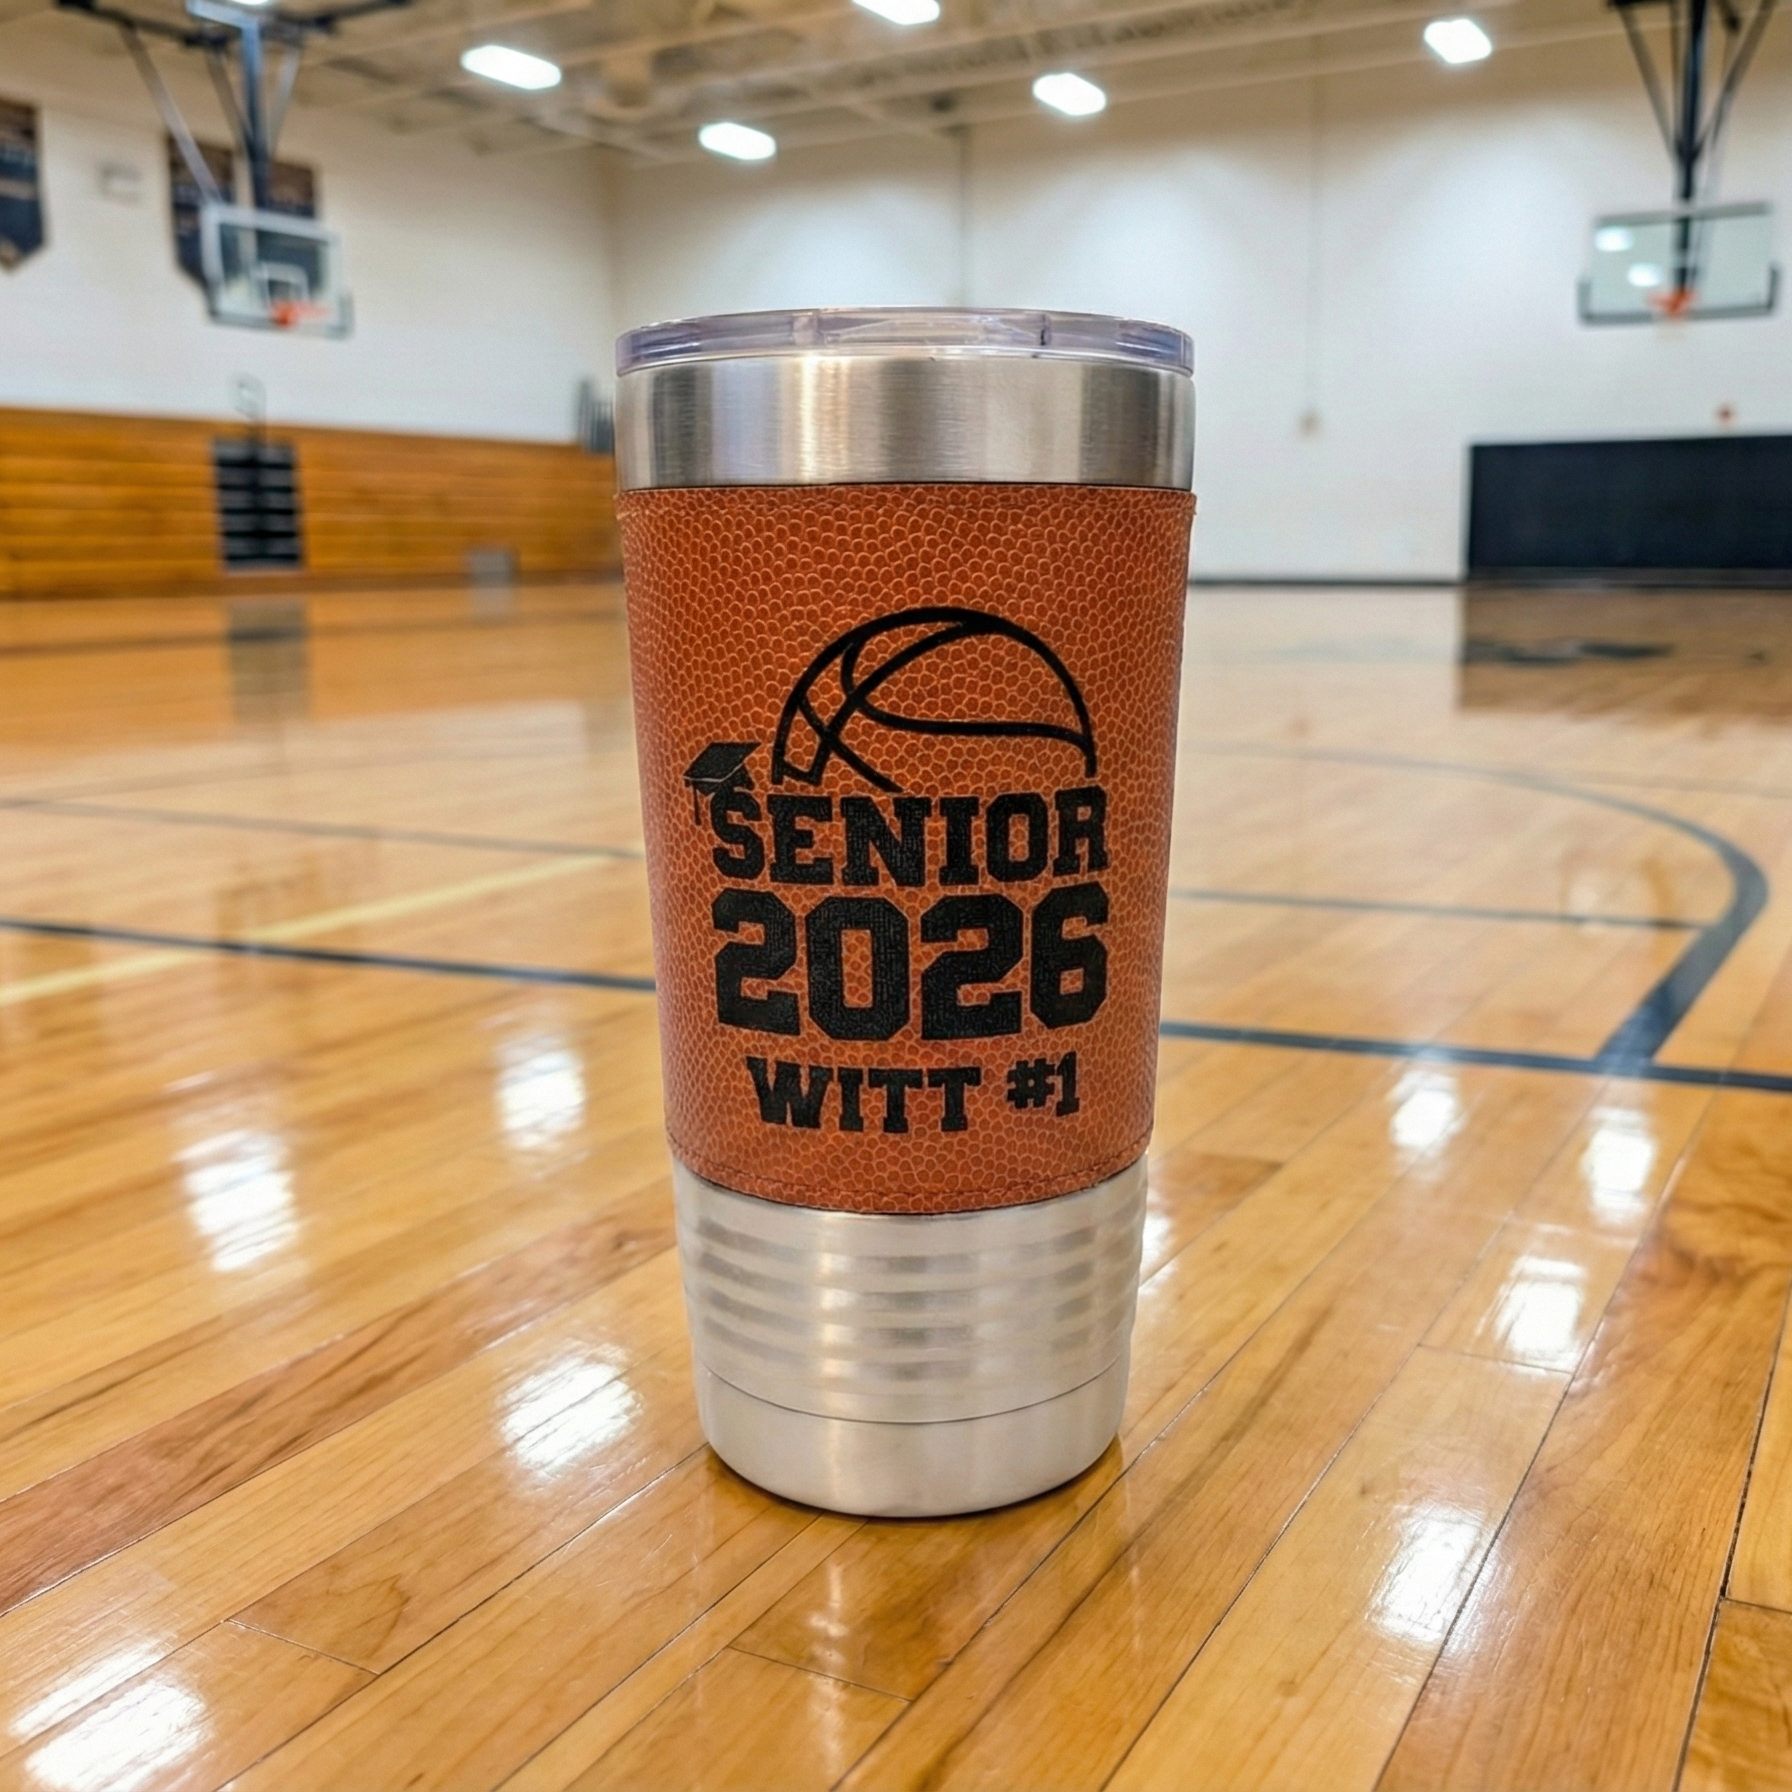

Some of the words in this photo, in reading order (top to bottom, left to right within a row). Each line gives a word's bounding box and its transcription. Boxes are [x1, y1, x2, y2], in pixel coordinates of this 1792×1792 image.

[711, 784, 1109, 888] SENIOR
[711, 881, 1109, 1041] 2026
[746, 1056, 981, 1134] WITT
[1006, 1051, 1080, 1117] #1
